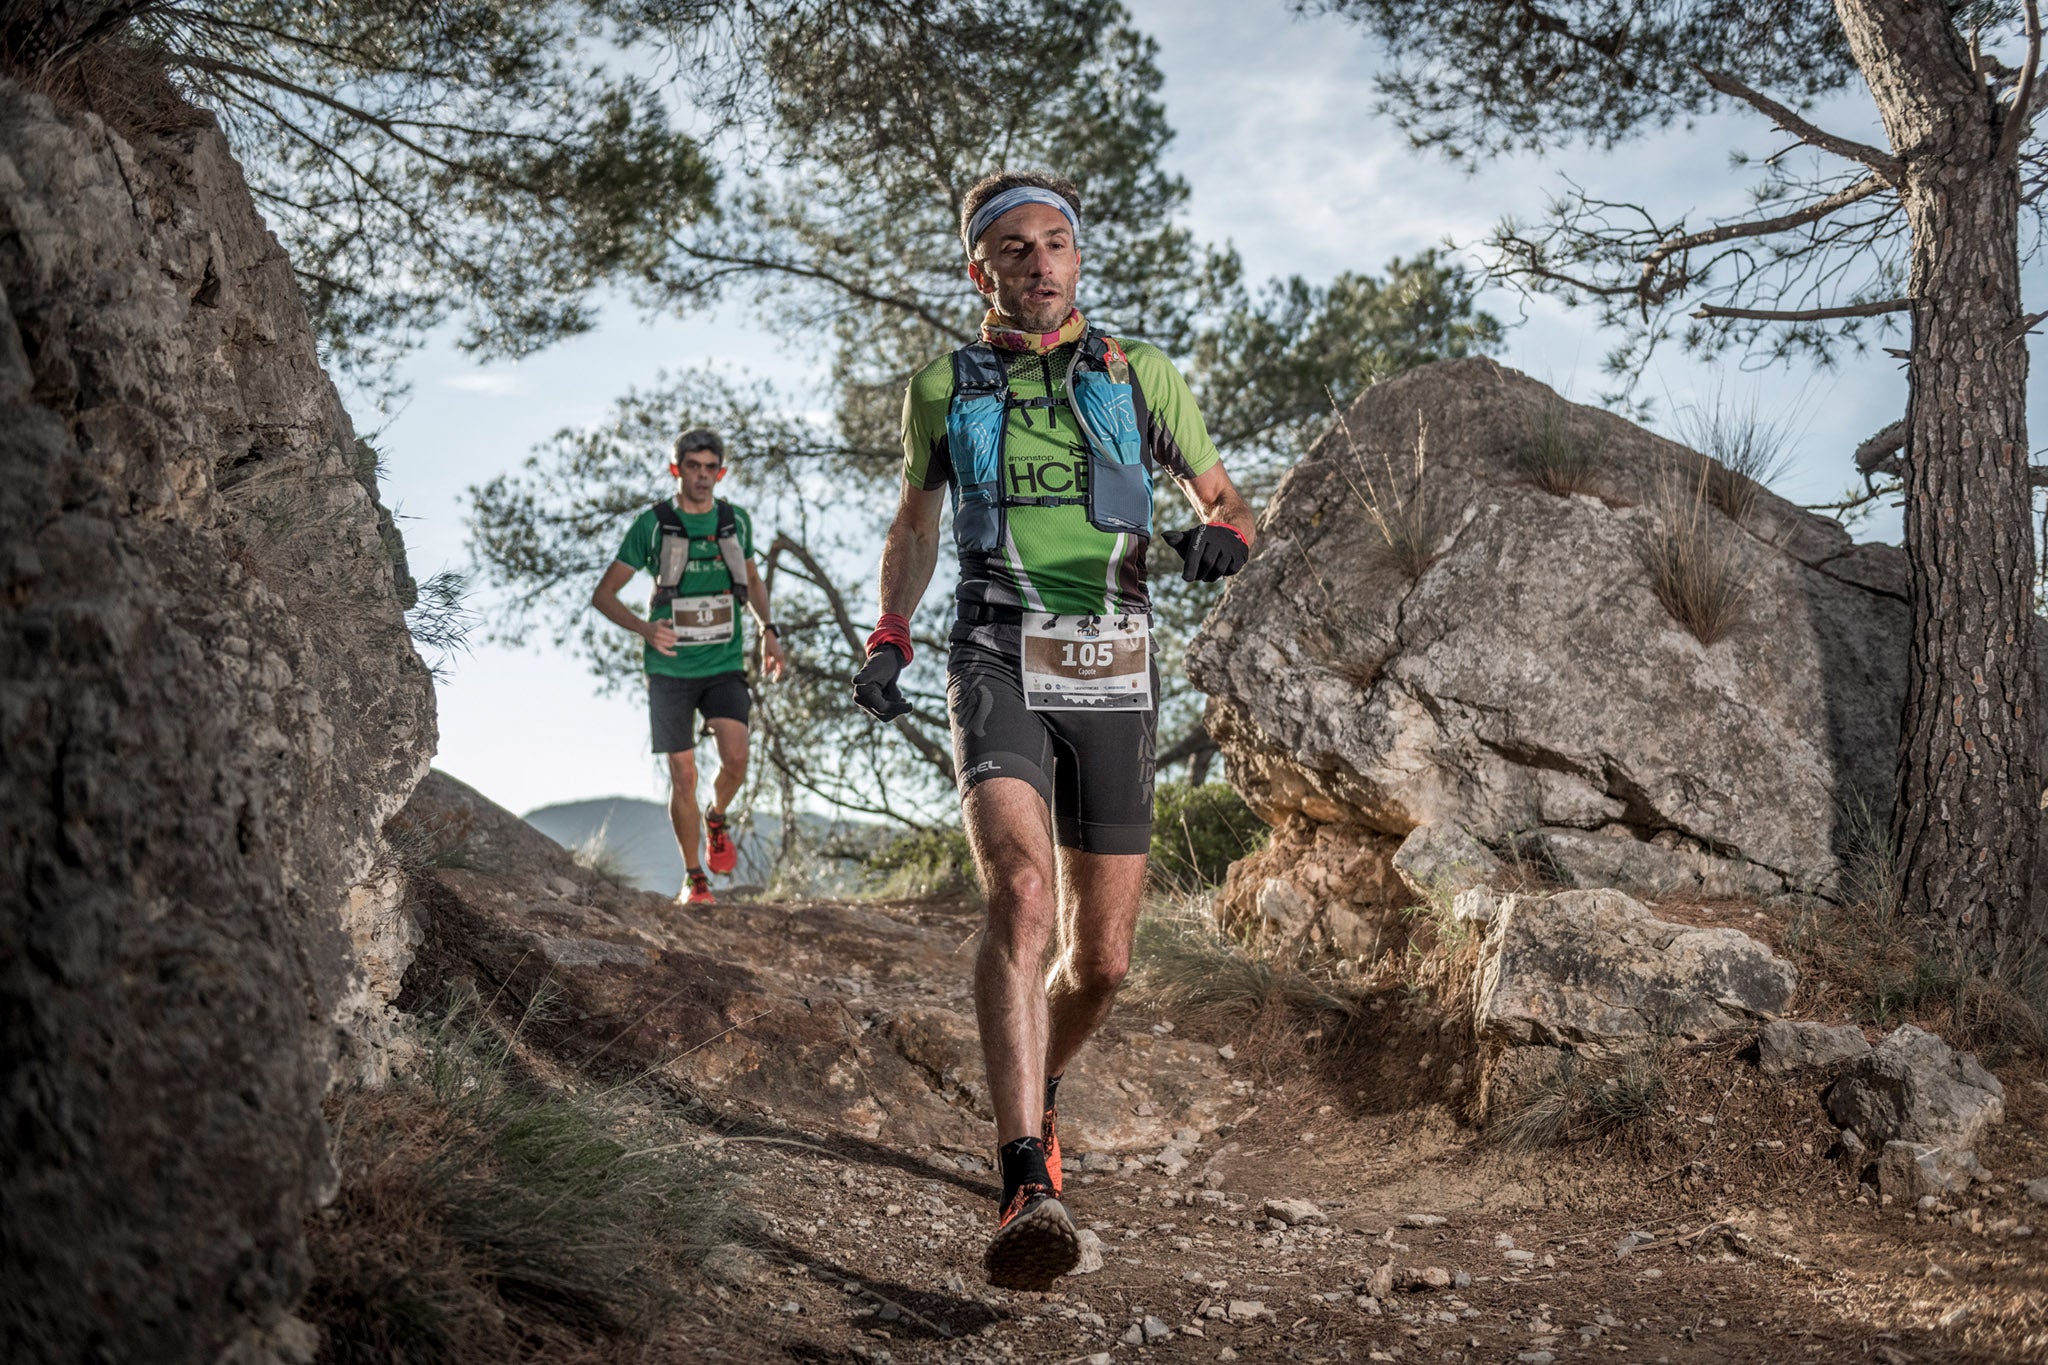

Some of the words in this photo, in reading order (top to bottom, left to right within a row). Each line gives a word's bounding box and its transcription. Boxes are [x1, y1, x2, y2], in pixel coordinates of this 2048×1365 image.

[1008, 455, 1055, 464] #nonstop
[1061, 643, 1114, 667] 105
[1078, 667, 1097, 677] Capote
